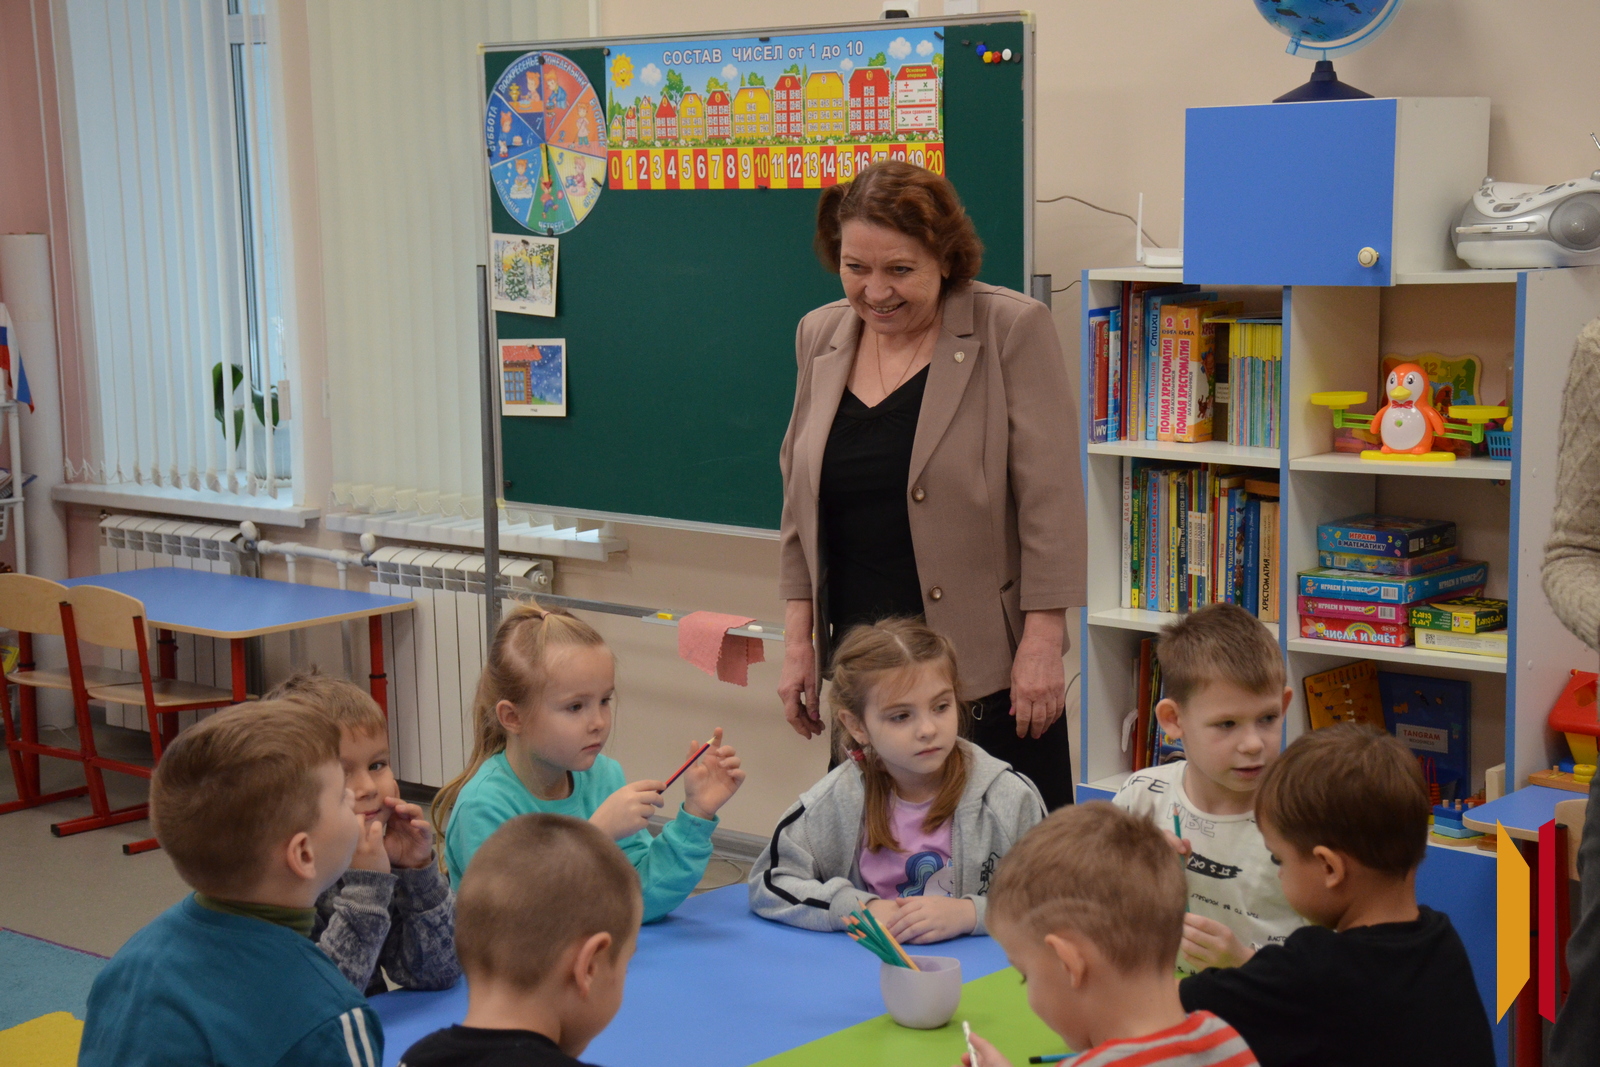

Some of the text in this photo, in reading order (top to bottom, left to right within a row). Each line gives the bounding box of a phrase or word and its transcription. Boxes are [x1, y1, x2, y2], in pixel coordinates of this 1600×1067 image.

[663, 40, 864, 66] СОСТАВ ЧИСЕЛ от 1 до 10
[499, 56, 539, 93] ВОСКРЕСЕНЬЕ
[544, 55, 588, 88] ПОНЕДЕЛЬНИК
[487, 105, 498, 152] СУББОТА
[611, 156, 620, 180] 0
[626, 156, 633, 180] 1
[639, 155, 648, 180] 2
[653, 155, 662, 179] 3
[667, 155, 677, 179] 4
[682, 155, 692, 179] 5
[696, 154, 706, 179] 6
[711, 154, 721, 179] 7
[726, 154, 736, 179] 8
[741, 153, 751, 179] 9
[755, 153, 769, 178] 10
[771, 153, 785, 179] 11
[788, 153, 802, 178] 12
[804, 152, 819, 178] 13
[820, 152, 835, 178] 14
[837, 151, 852, 177] 15
[854, 151, 870, 176] 16
[926, 150, 943, 175] 20
[1150, 314, 1158, 347] Стихи
[1165, 317, 1174, 328] 2
[1183, 317, 1191, 329] 1
[1423, 362, 1438, 375] 12
[1160, 338, 1173, 433] ПОЛНАЯ ХРЕСТОМАТИЯ
[1176, 339, 1190, 434] ПОЛНАЯ ХРЕСТОМАТИЯ
[1343, 540, 1386, 551] МАТЕМАТИКУ
[1349, 532, 1376, 541] ИГРАЕМ
[1262, 558, 1270, 611] ХРЕСТОМАТИЯ
[1318, 603, 1338, 611] ИГРАЕМ
[1323, 629, 1358, 641] ЧИСЛА
[1361, 633, 1368, 642] И
[1372, 633, 1397, 645] СЧЁТ
[1403, 729, 1441, 741] TANGRAM
[1119, 775, 1170, 794] LIFE
[1190, 893, 1219, 906] YOURSELF
